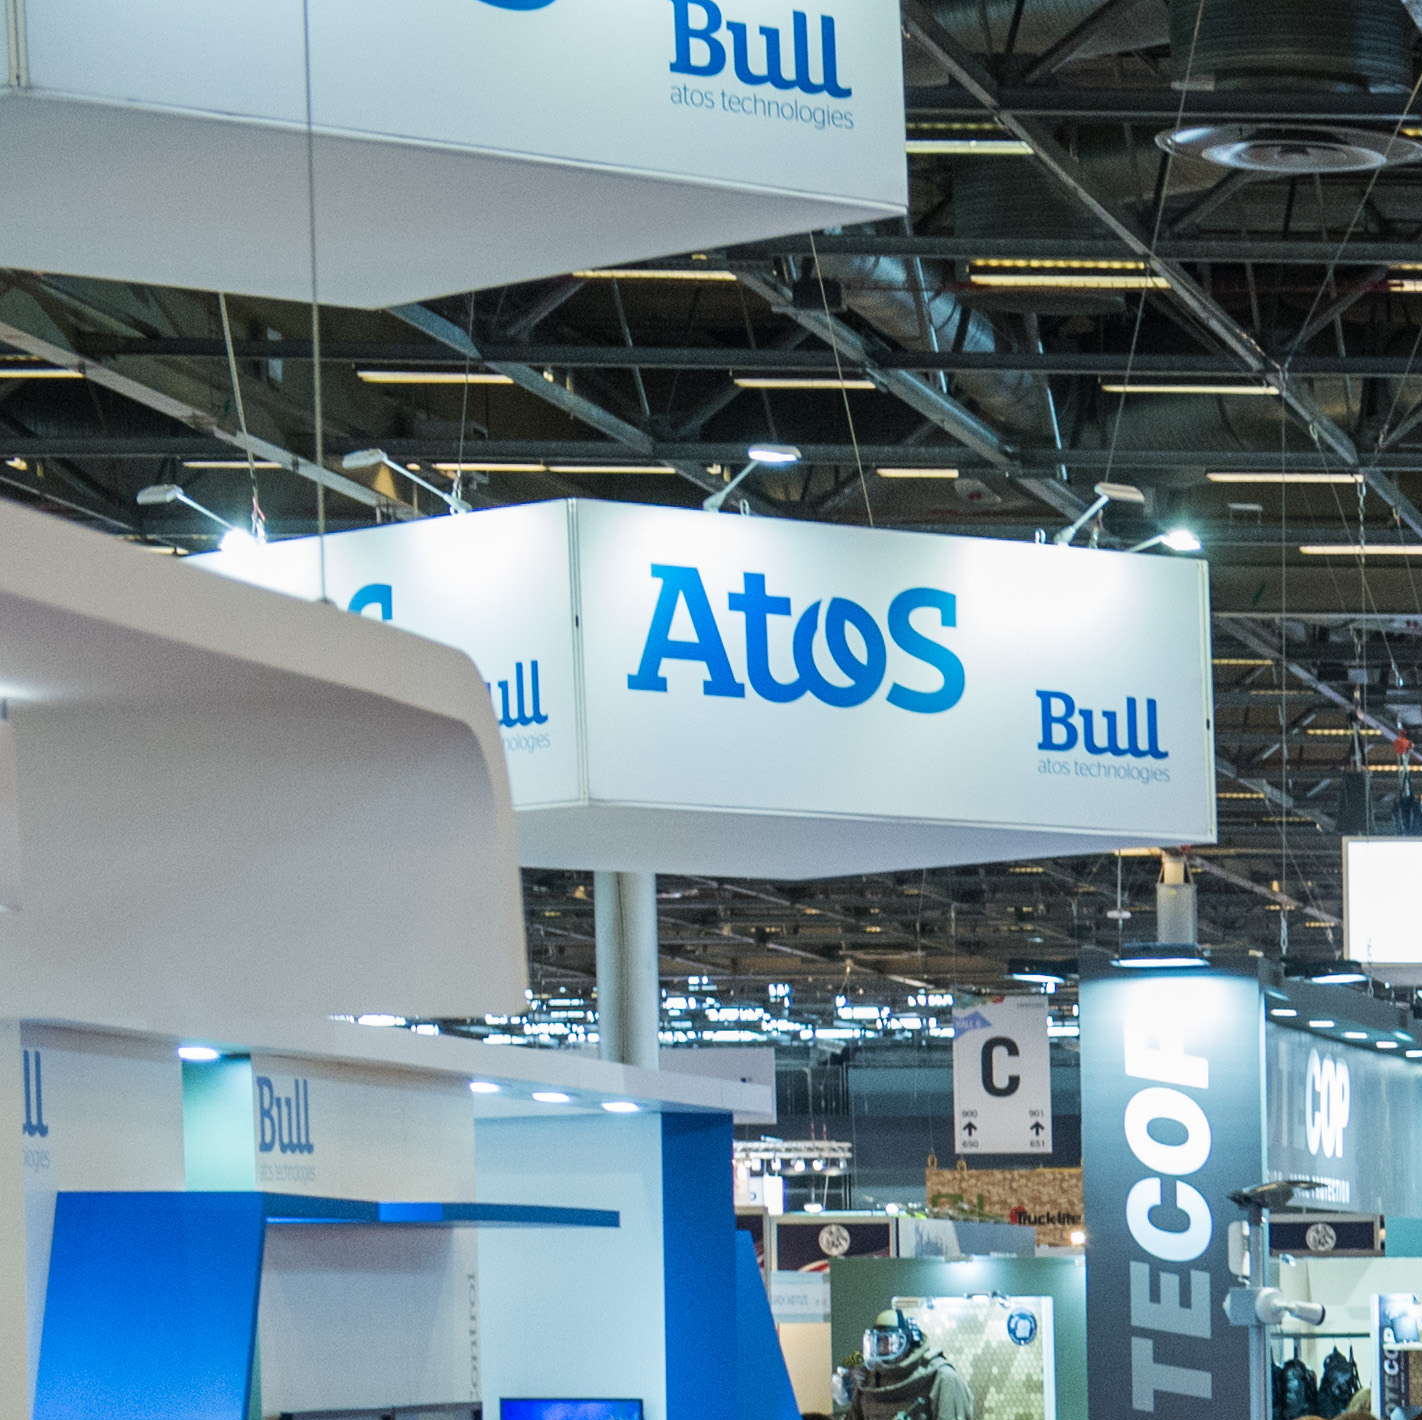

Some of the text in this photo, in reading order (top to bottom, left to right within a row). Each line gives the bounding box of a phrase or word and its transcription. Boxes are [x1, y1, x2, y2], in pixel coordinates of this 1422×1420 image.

[669, 0, 852, 98] Bull
[670, 84, 854, 130] atos technologies
[1035, 689, 1169, 759] Bull
[1037, 757, 1171, 784] atos technologies
[981, 1036, 1021, 1097] C
[255, 1075, 314, 1155] Bull
